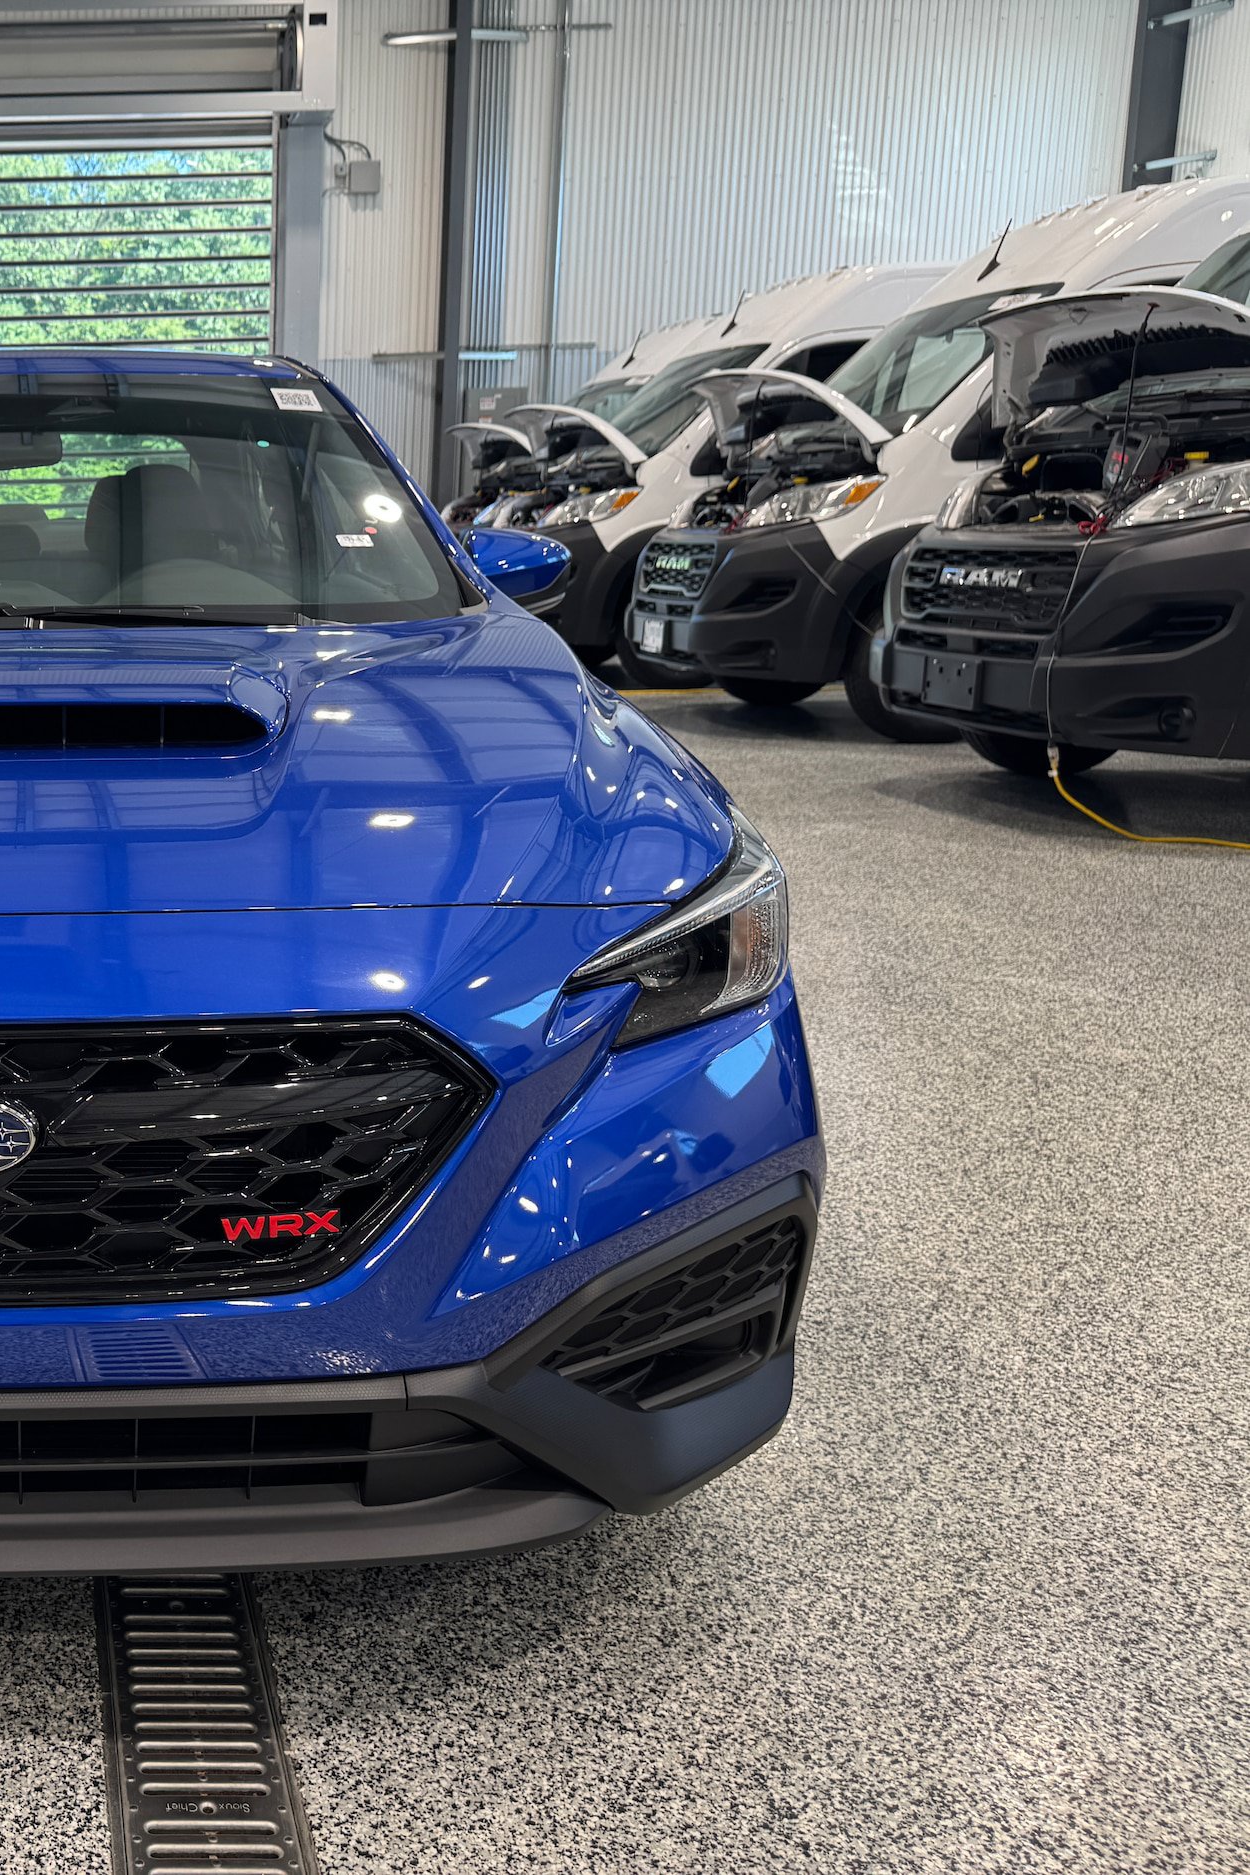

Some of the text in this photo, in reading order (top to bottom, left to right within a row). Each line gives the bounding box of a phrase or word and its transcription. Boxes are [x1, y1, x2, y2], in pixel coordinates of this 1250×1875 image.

[655, 555, 691, 570] RAM
[939, 567, 1023, 588] RAM
[220, 1209, 340, 1241] WRX
[165, 1802, 251, 1813] Sioux Chief
